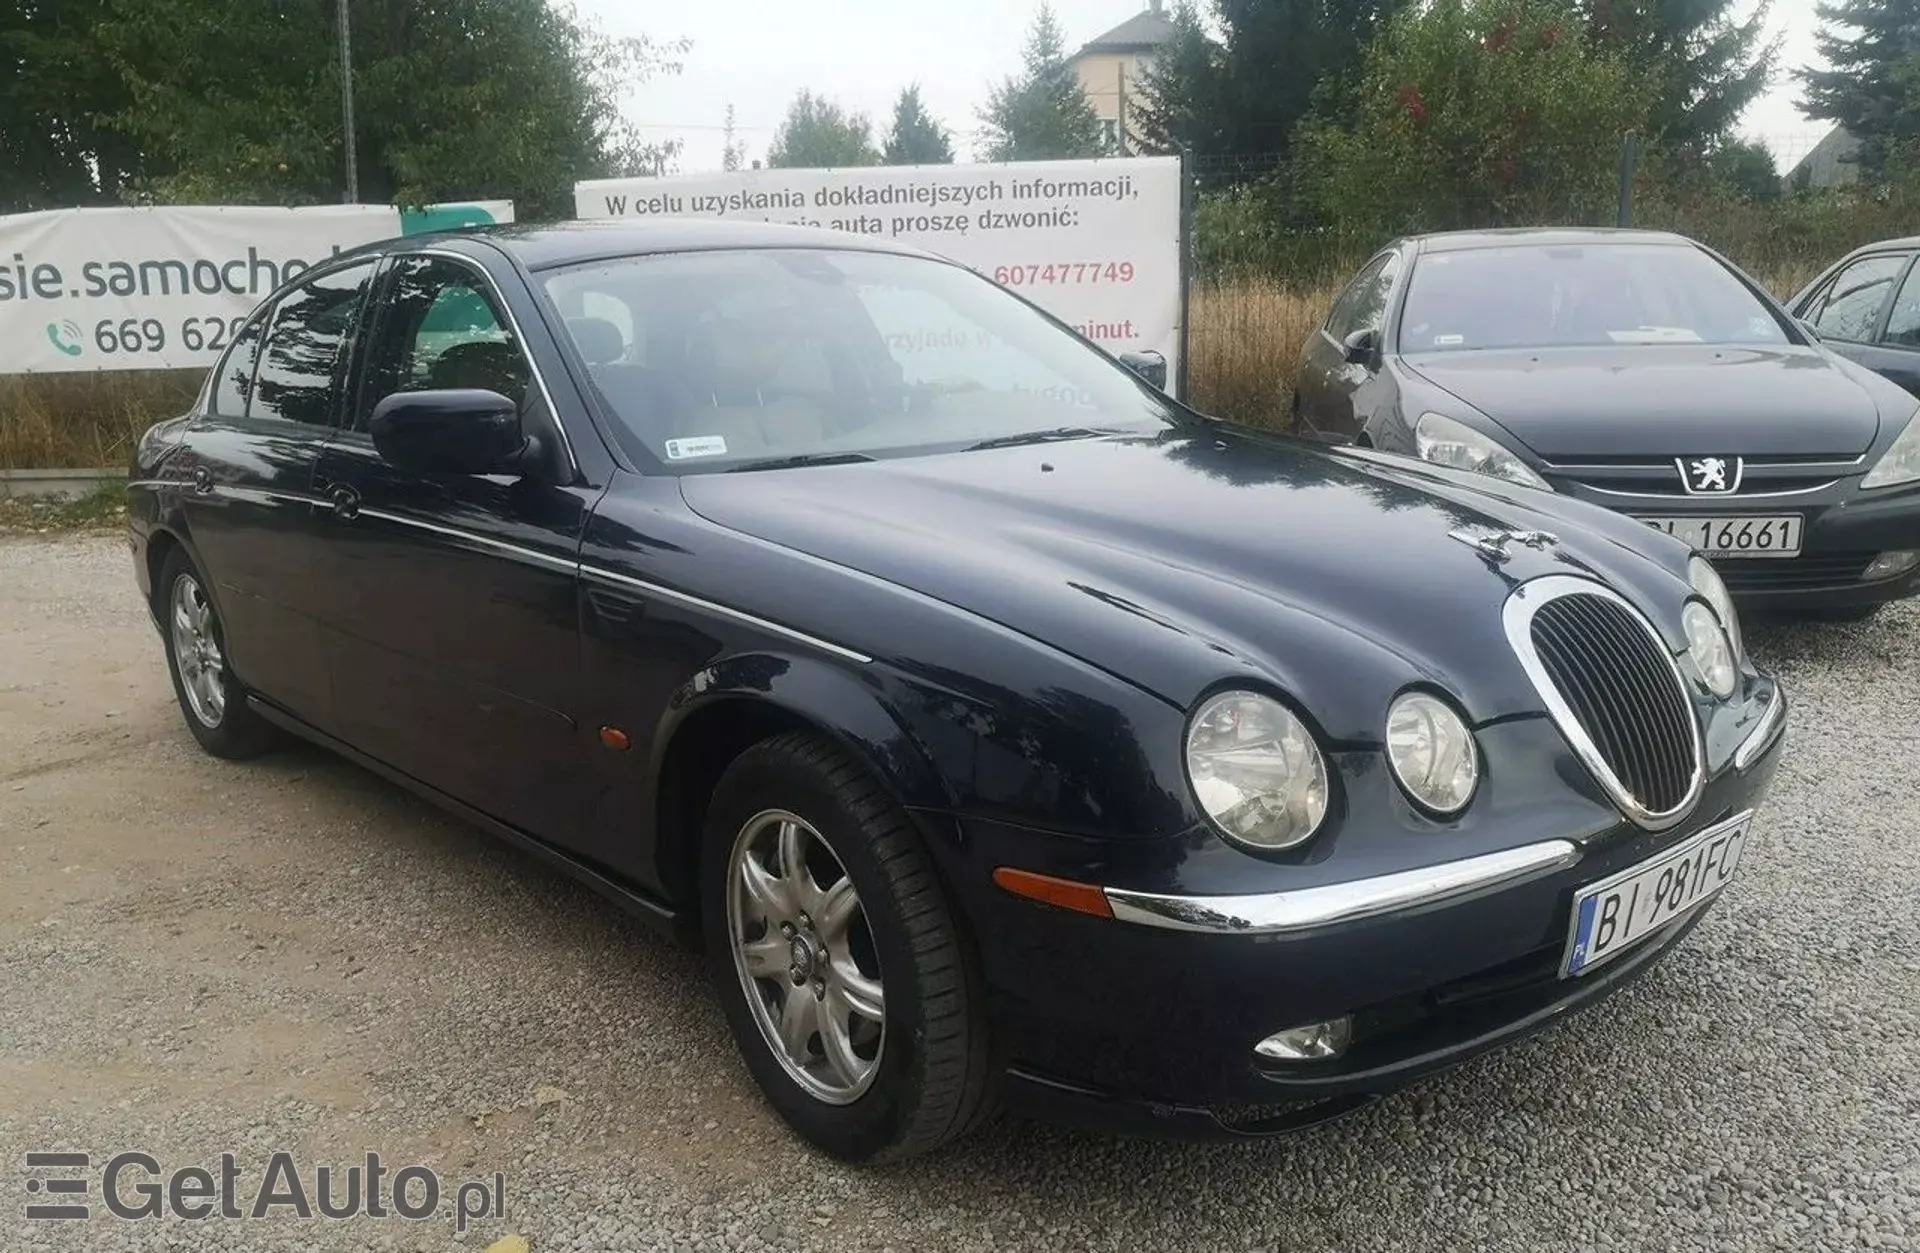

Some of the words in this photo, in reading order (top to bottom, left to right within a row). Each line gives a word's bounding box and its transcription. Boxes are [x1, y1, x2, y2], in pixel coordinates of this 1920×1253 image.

[604, 194, 627, 216] W
[635, 193, 682, 215] celu
[691, 188, 806, 216] uzyskania
[814, 180, 1003, 207] dokładniejszych
[1012, 174, 1139, 201] informacji,
[831, 214, 882, 234] auta
[892, 210, 970, 237] proszę
[978, 204, 1079, 230] dzwonić:
[994, 262, 1134, 286] 607477749
[94, 318, 165, 353] 669
[1701, 520, 1789, 549] 16661
[1595, 882, 1640, 952] BI
[1649, 829, 1741, 924] 981FC
